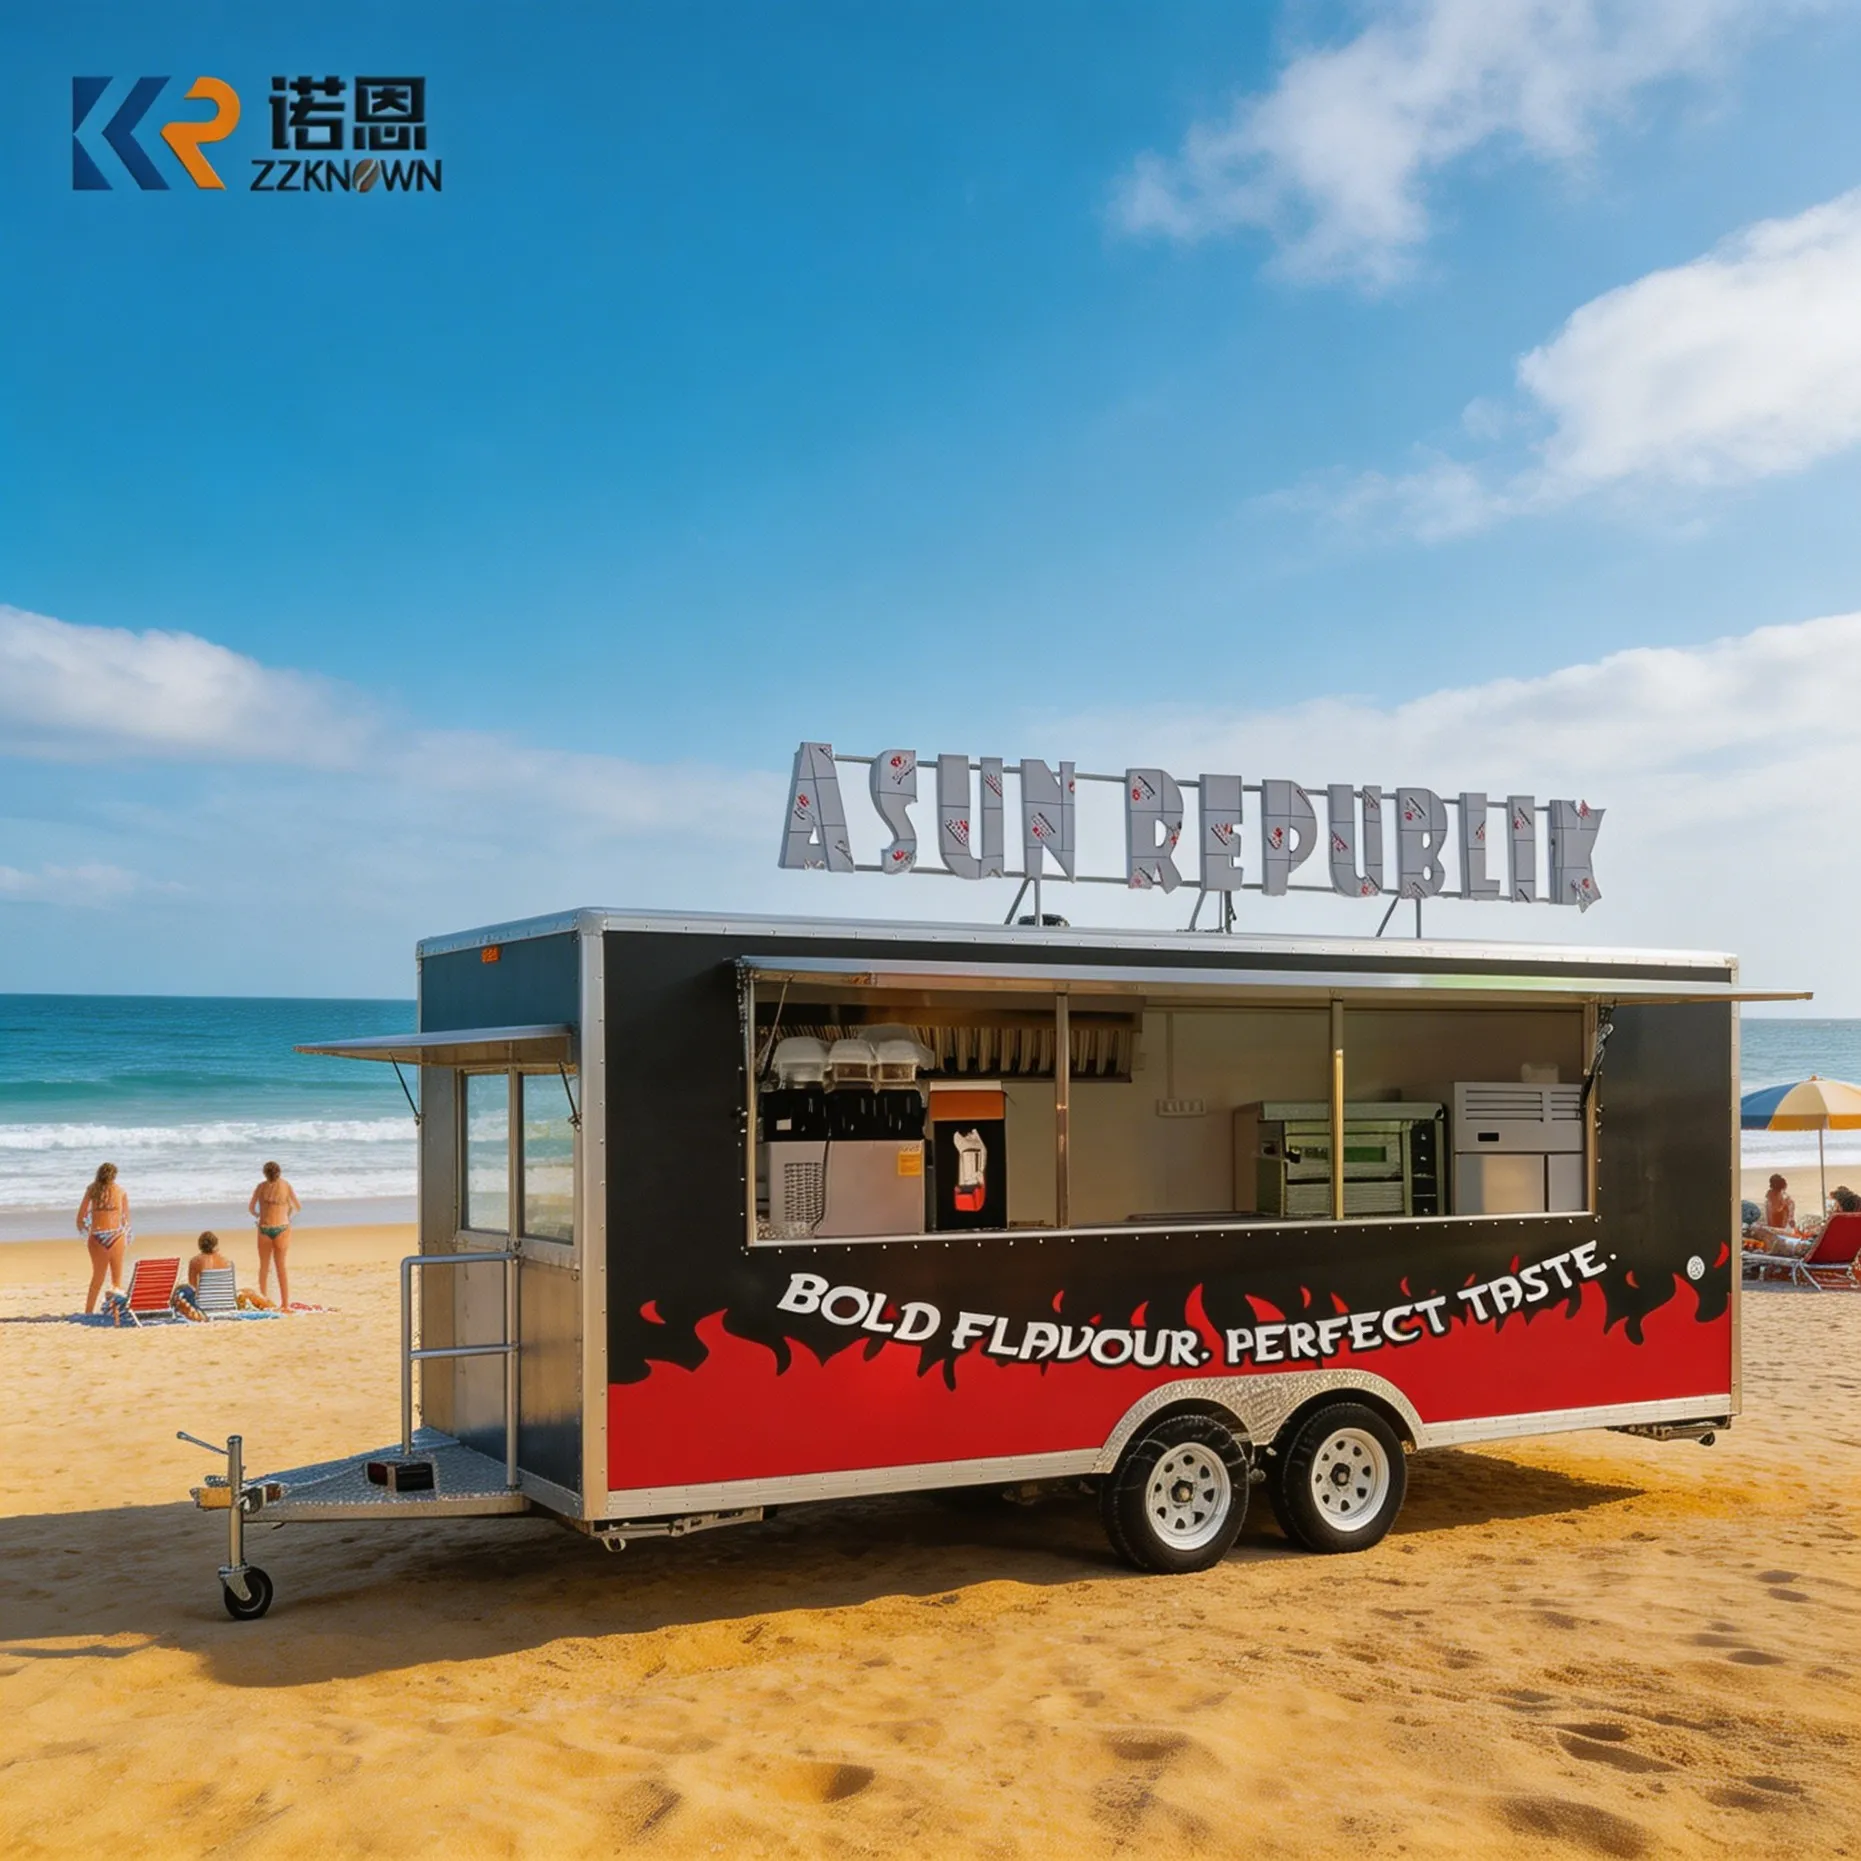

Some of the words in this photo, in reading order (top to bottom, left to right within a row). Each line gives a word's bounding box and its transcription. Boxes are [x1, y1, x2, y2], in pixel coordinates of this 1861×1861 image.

[778, 742, 1076, 883] ASUN
[1125, 768, 1607, 913] REPUBLIK
[776, 1272, 942, 1341] BOLD
[951, 1310, 1211, 1367] FLAVOUR.
[1225, 1295, 1447, 1364] PERFECT
[1456, 1238, 1618, 1320] TASTE.
